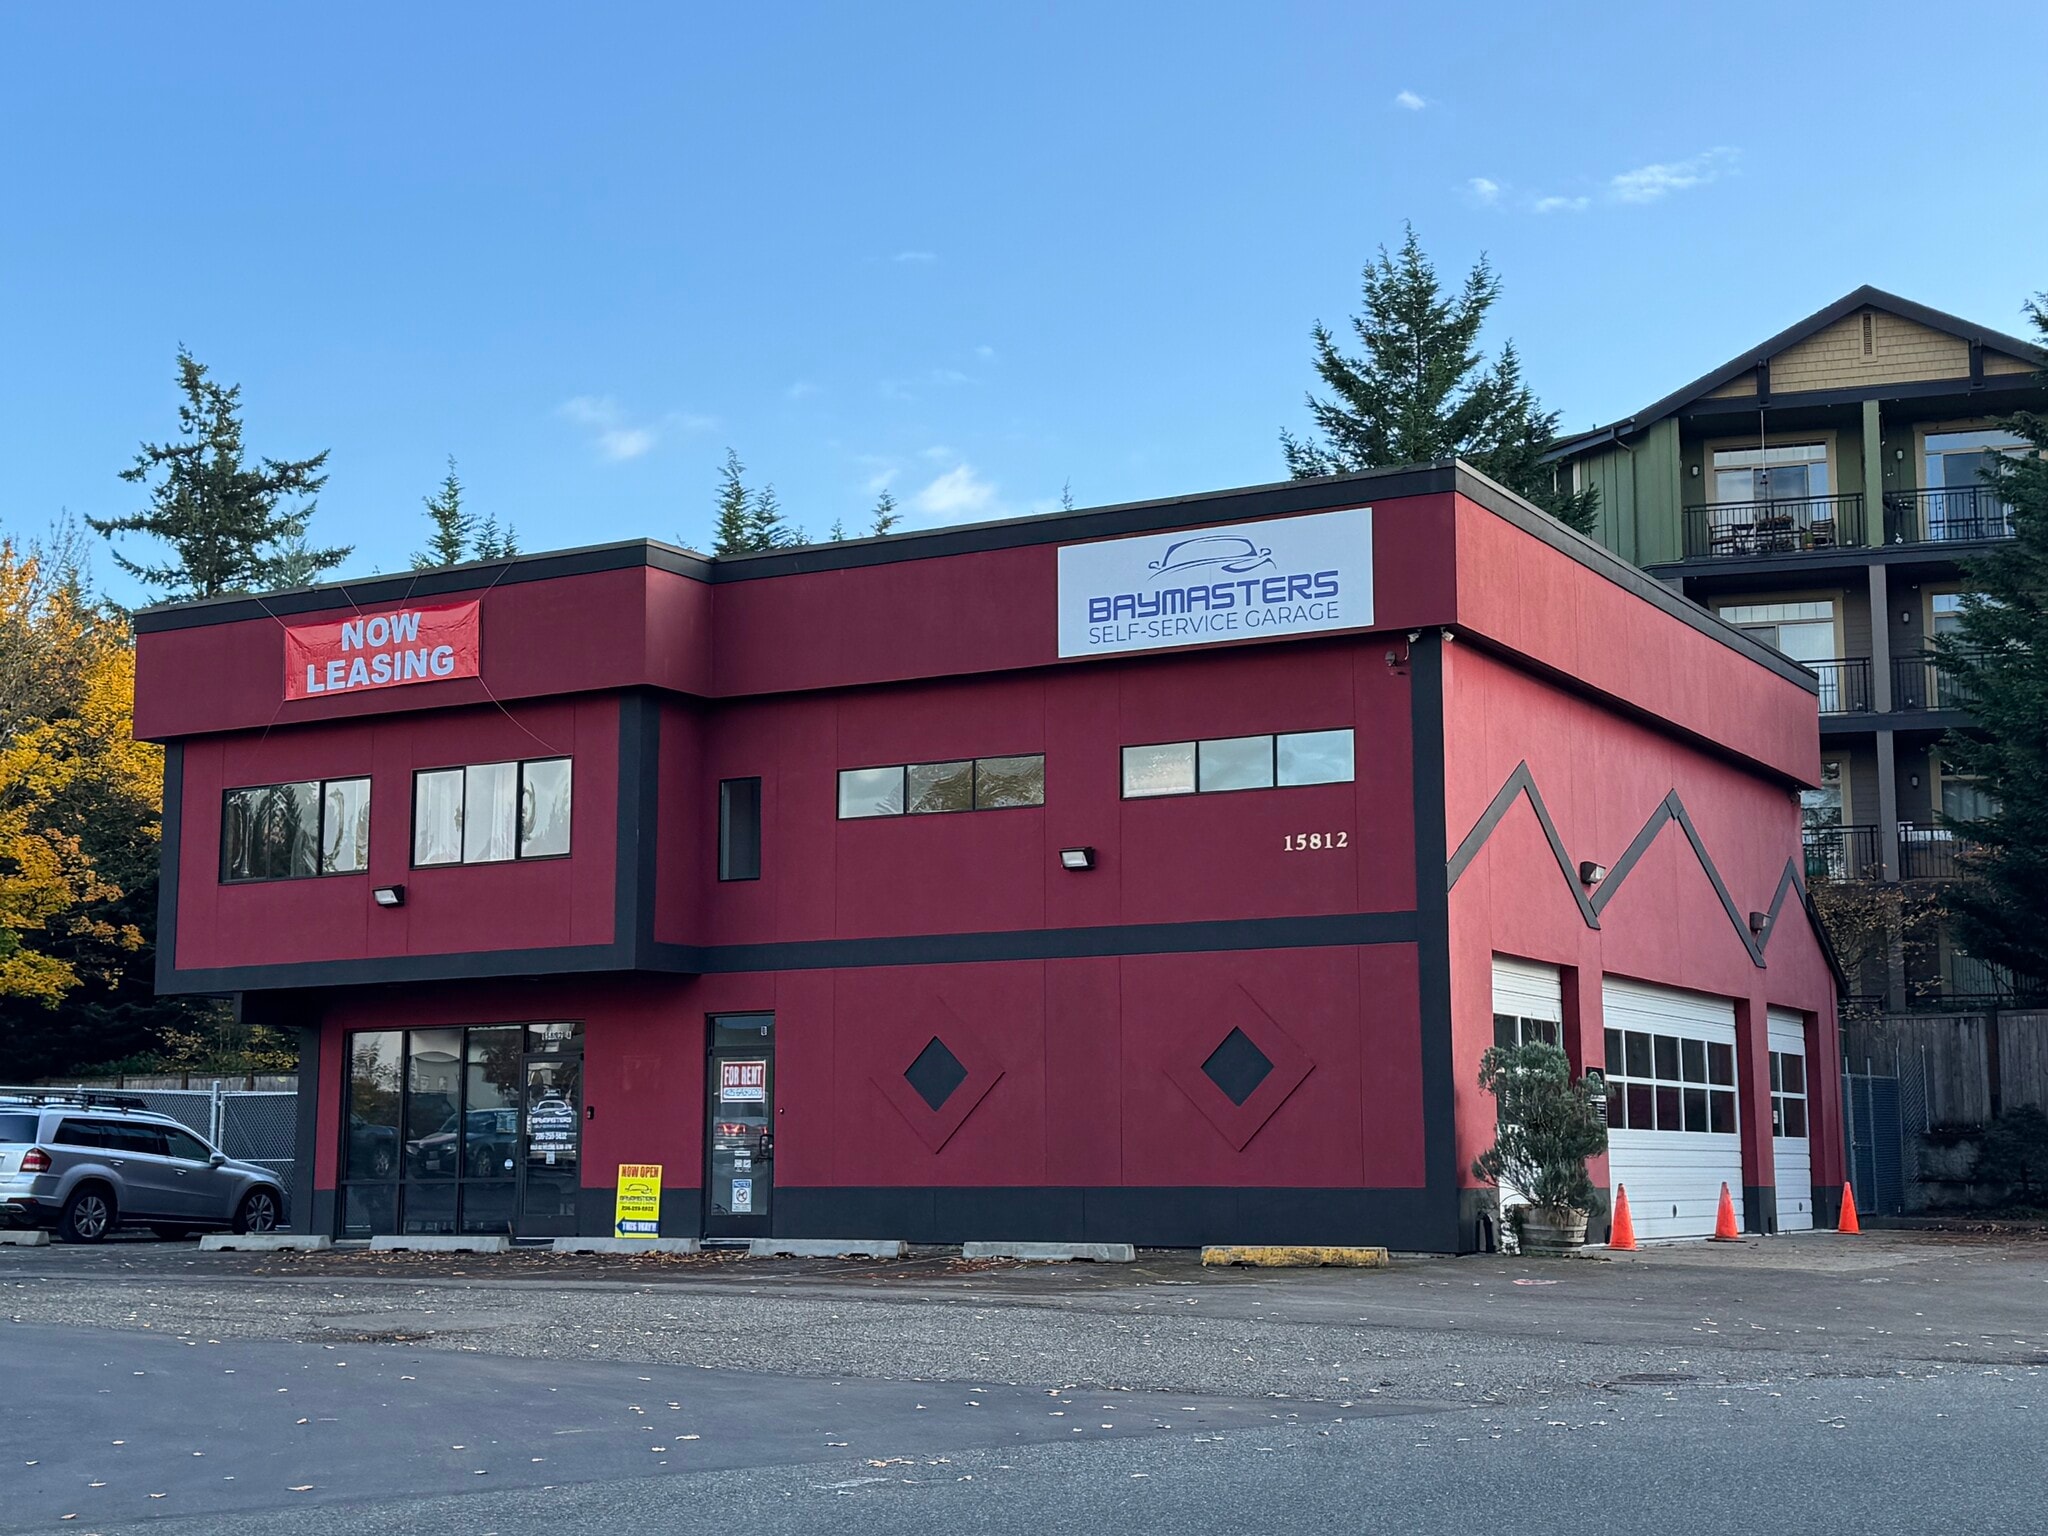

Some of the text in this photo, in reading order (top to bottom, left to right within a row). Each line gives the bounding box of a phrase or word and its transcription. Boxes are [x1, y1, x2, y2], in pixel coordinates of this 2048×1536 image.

[1089, 570, 1339, 623] BAYMASTERS
[341, 612, 422, 651] NOW
[1089, 601, 1339, 644] SELF-SERVICE GARAGE
[307, 645, 454, 693] LEASING
[1284, 831, 1348, 852] 15812
[724, 1065, 763, 1086] FOR RENT
[621, 1166, 659, 1178] NOW OPEN
